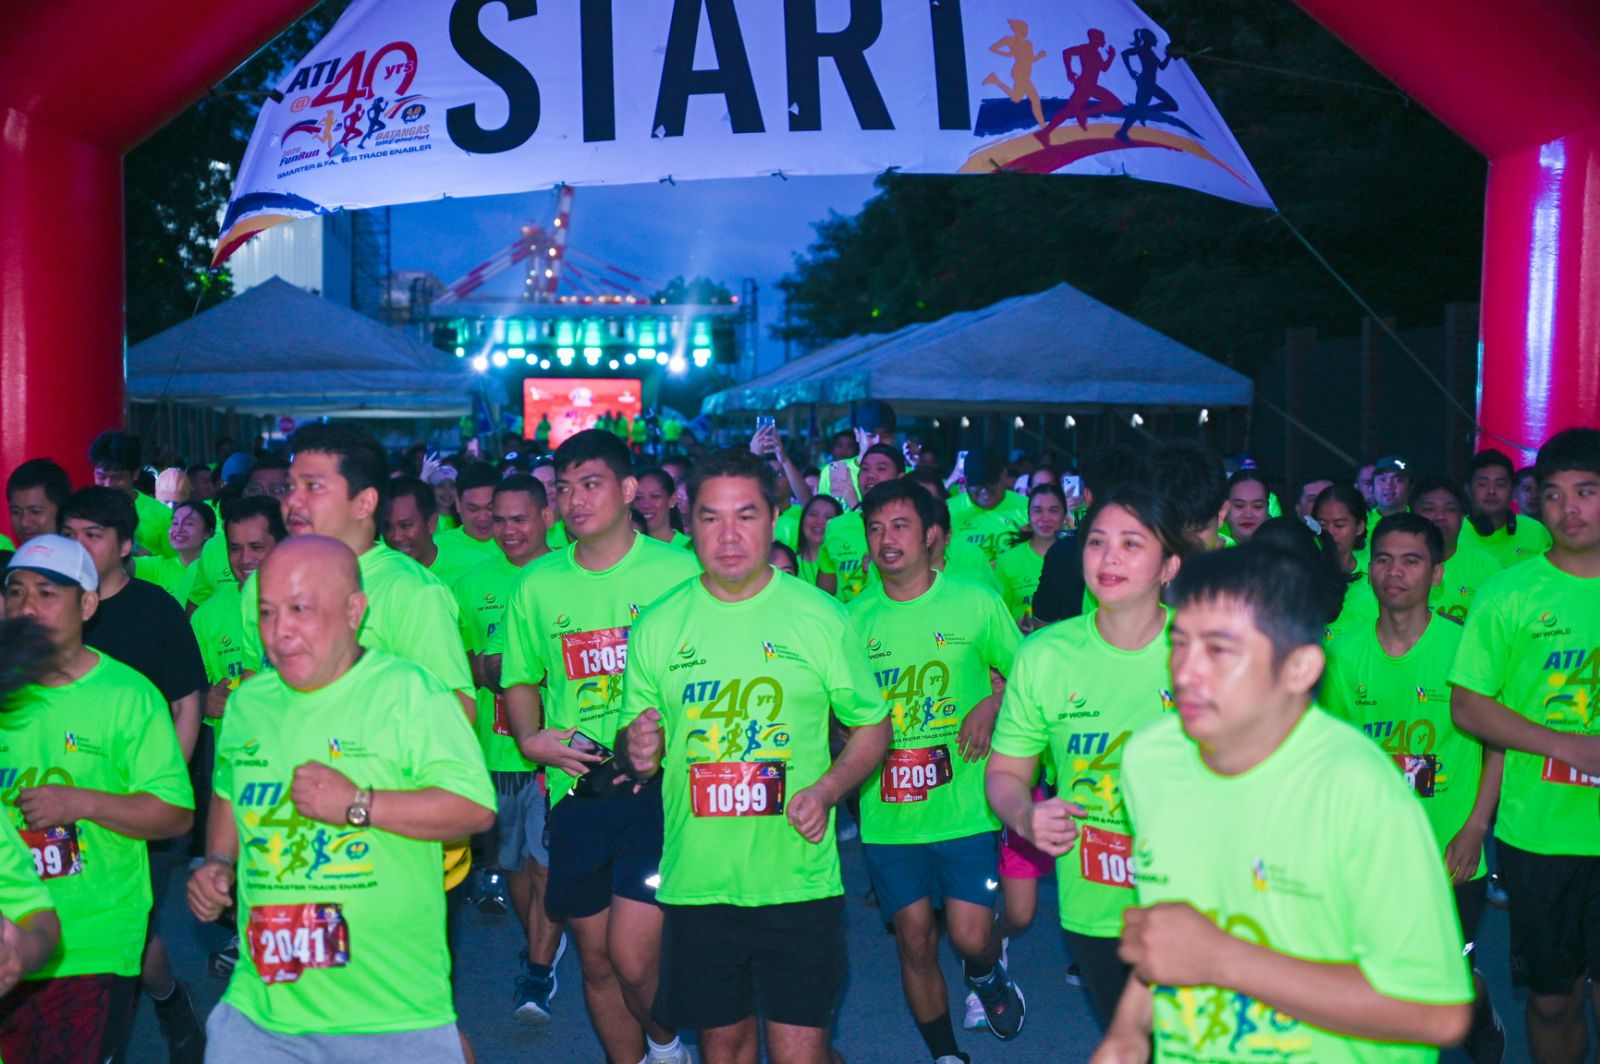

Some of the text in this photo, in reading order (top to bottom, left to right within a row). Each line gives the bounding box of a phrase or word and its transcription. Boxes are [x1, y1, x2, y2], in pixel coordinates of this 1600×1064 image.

[286, 41, 418, 113] ATI 40
[383, 61, 414, 79] yrs
[290, 96, 311, 113] @
[375, 125, 431, 141] BATANGAS
[277, 144, 433, 180] SMARTER & FATER TRADE ENABLER
[279, 149, 320, 167] FunRun
[1531, 628, 1572, 640] DP WORLD
[580, 644, 627, 675] 1305
[669, 659, 707, 672] DP WORLD
[869, 650, 892, 660] WORLD
[1543, 649, 1586, 671] ATI
[887, 660, 950, 706] 40
[682, 676, 784, 729] ATI 40
[1058, 710, 1100, 720] DP WORLD
[1067, 732, 1109, 755] ATI
[891, 763, 937, 789] 1209
[238, 782, 284, 806] ATI
[707, 783, 767, 813] 1099
[261, 927, 325, 965] 2041
